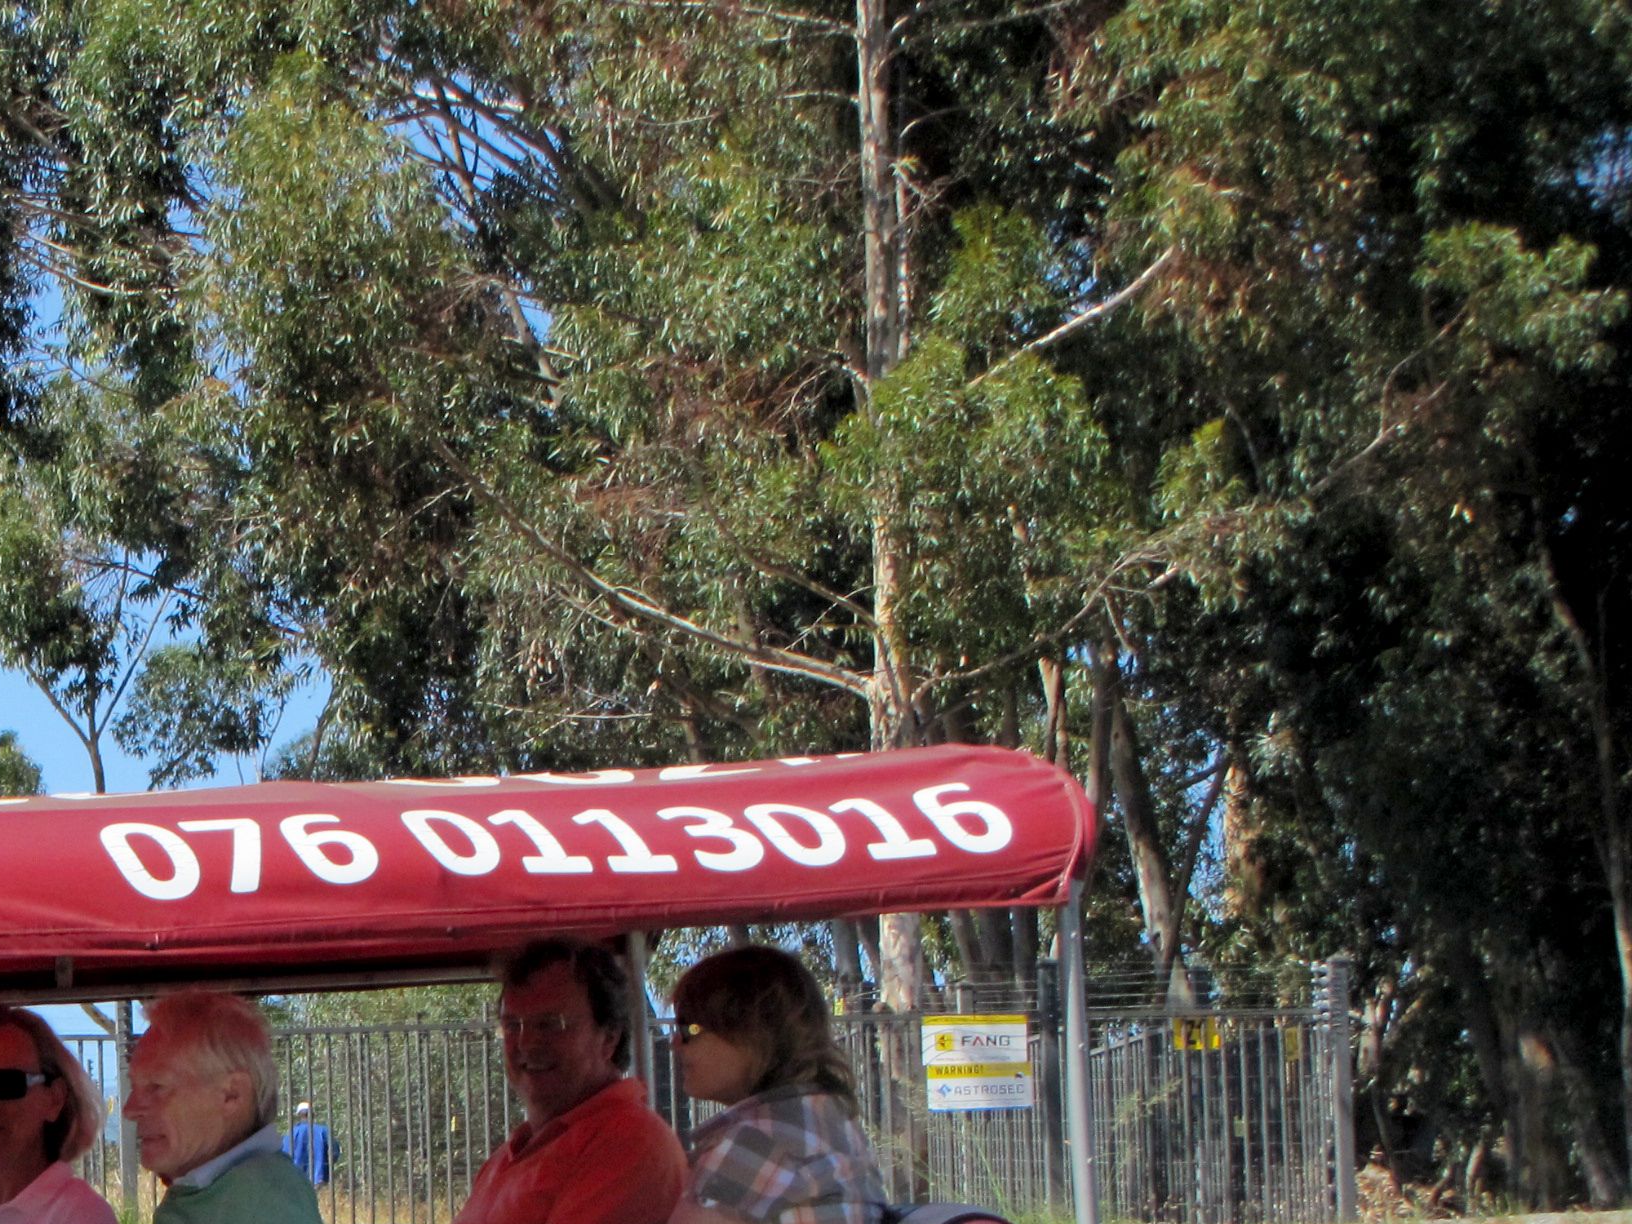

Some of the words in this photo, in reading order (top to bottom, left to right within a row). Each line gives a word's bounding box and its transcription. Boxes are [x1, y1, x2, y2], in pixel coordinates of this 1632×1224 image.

[99, 813, 378, 900] 076
[401, 782, 1013, 876] 0113016
[961, 1035, 1010, 1047] FANG
[935, 1065, 984, 1076] WARNING!
[954, 1084, 1025, 1096] ASTROSEC
